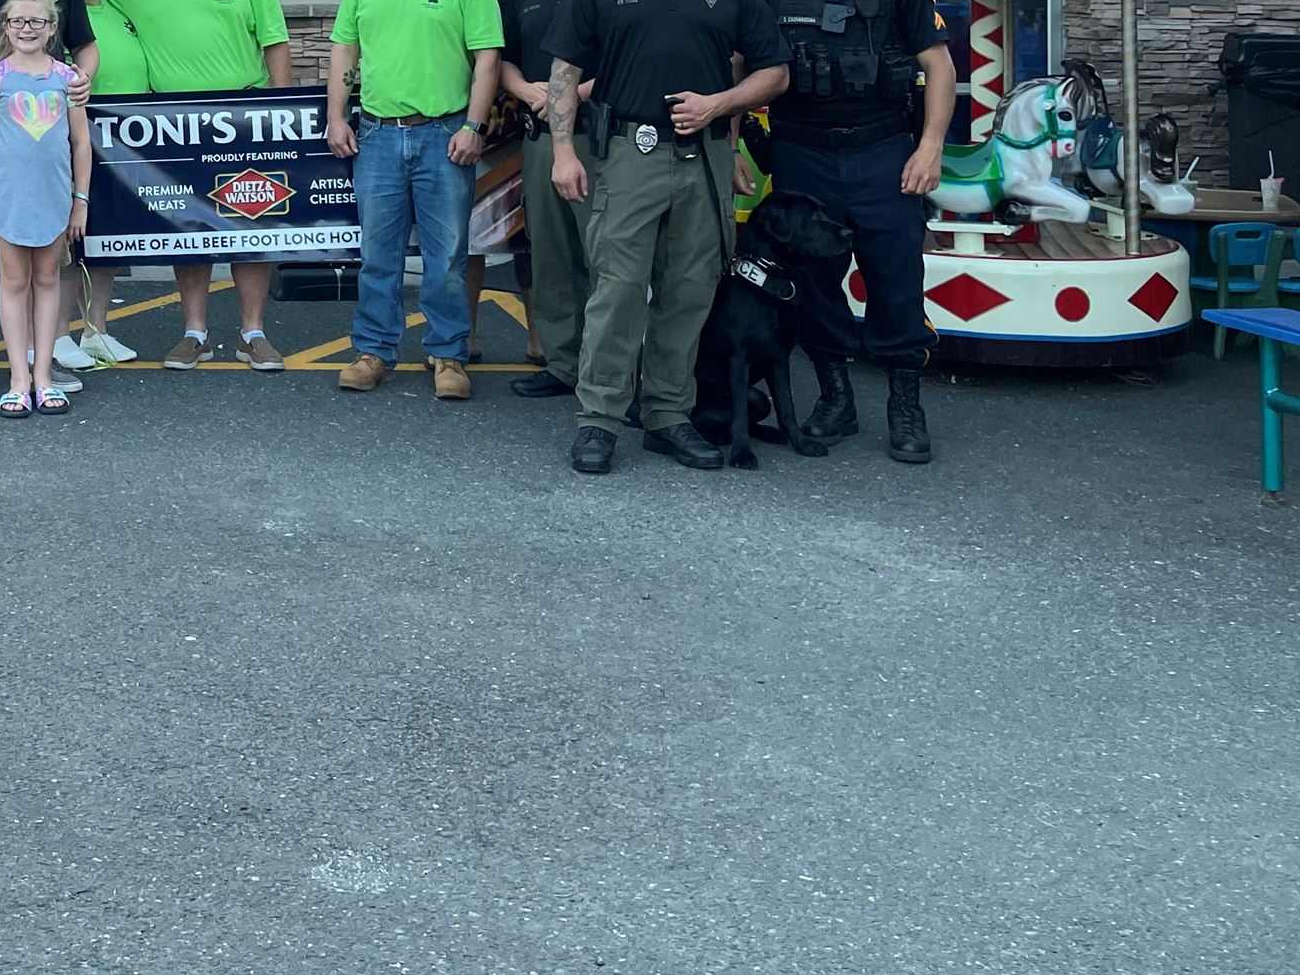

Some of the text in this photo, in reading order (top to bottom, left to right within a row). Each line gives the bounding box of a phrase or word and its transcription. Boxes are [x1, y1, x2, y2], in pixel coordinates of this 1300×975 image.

[94, 107, 328, 148] TONI'S TRE
[202, 151, 298, 163] PROUDLY FEATURING
[232, 181, 262, 193] DIETZ
[310, 178, 355, 190] ARTISA
[138, 185, 194, 197] PREMIUM
[225, 191, 276, 203] WATSON
[148, 199, 186, 211] MEATS
[101, 230, 361, 252] HOME OF ALL BEEF FOOT LONG HOT
